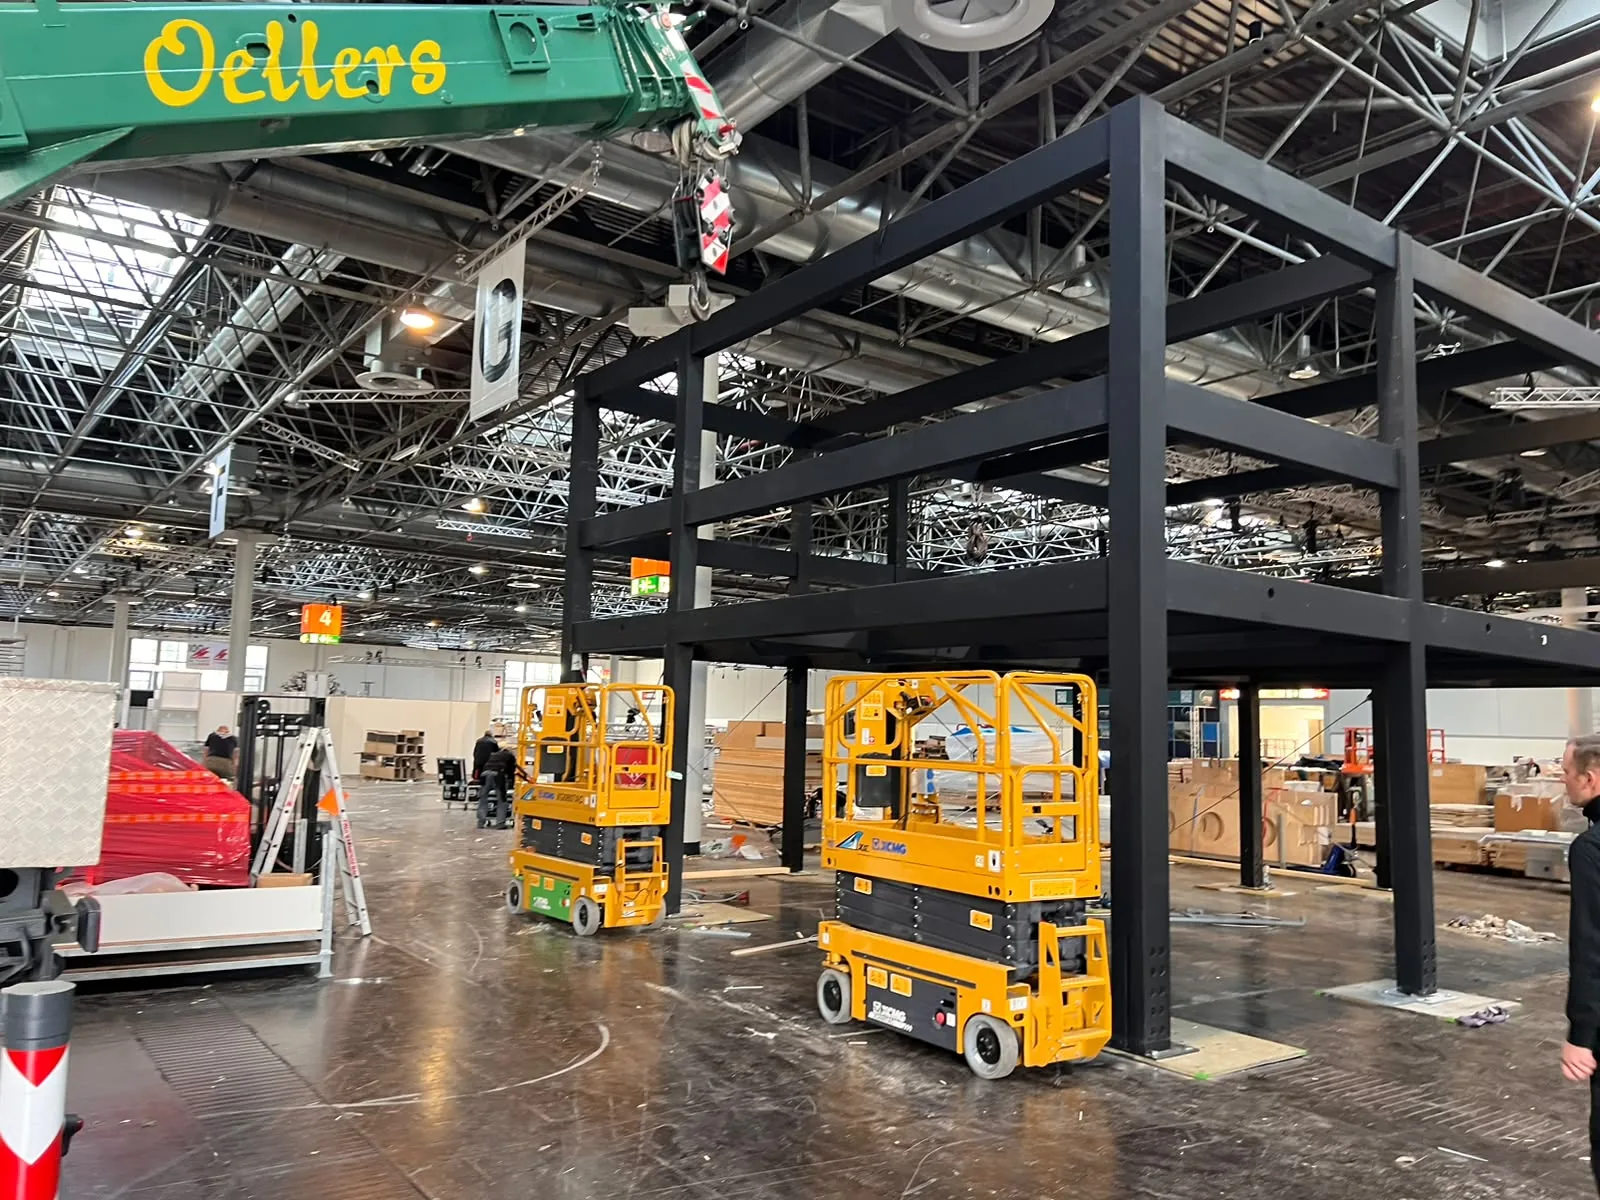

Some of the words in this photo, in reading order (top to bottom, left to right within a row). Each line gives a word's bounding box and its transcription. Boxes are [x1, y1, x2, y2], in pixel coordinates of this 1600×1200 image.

[144, 19, 446, 106] Oellers
[479, 278, 517, 383] G
[319, 609, 332, 627] 4
